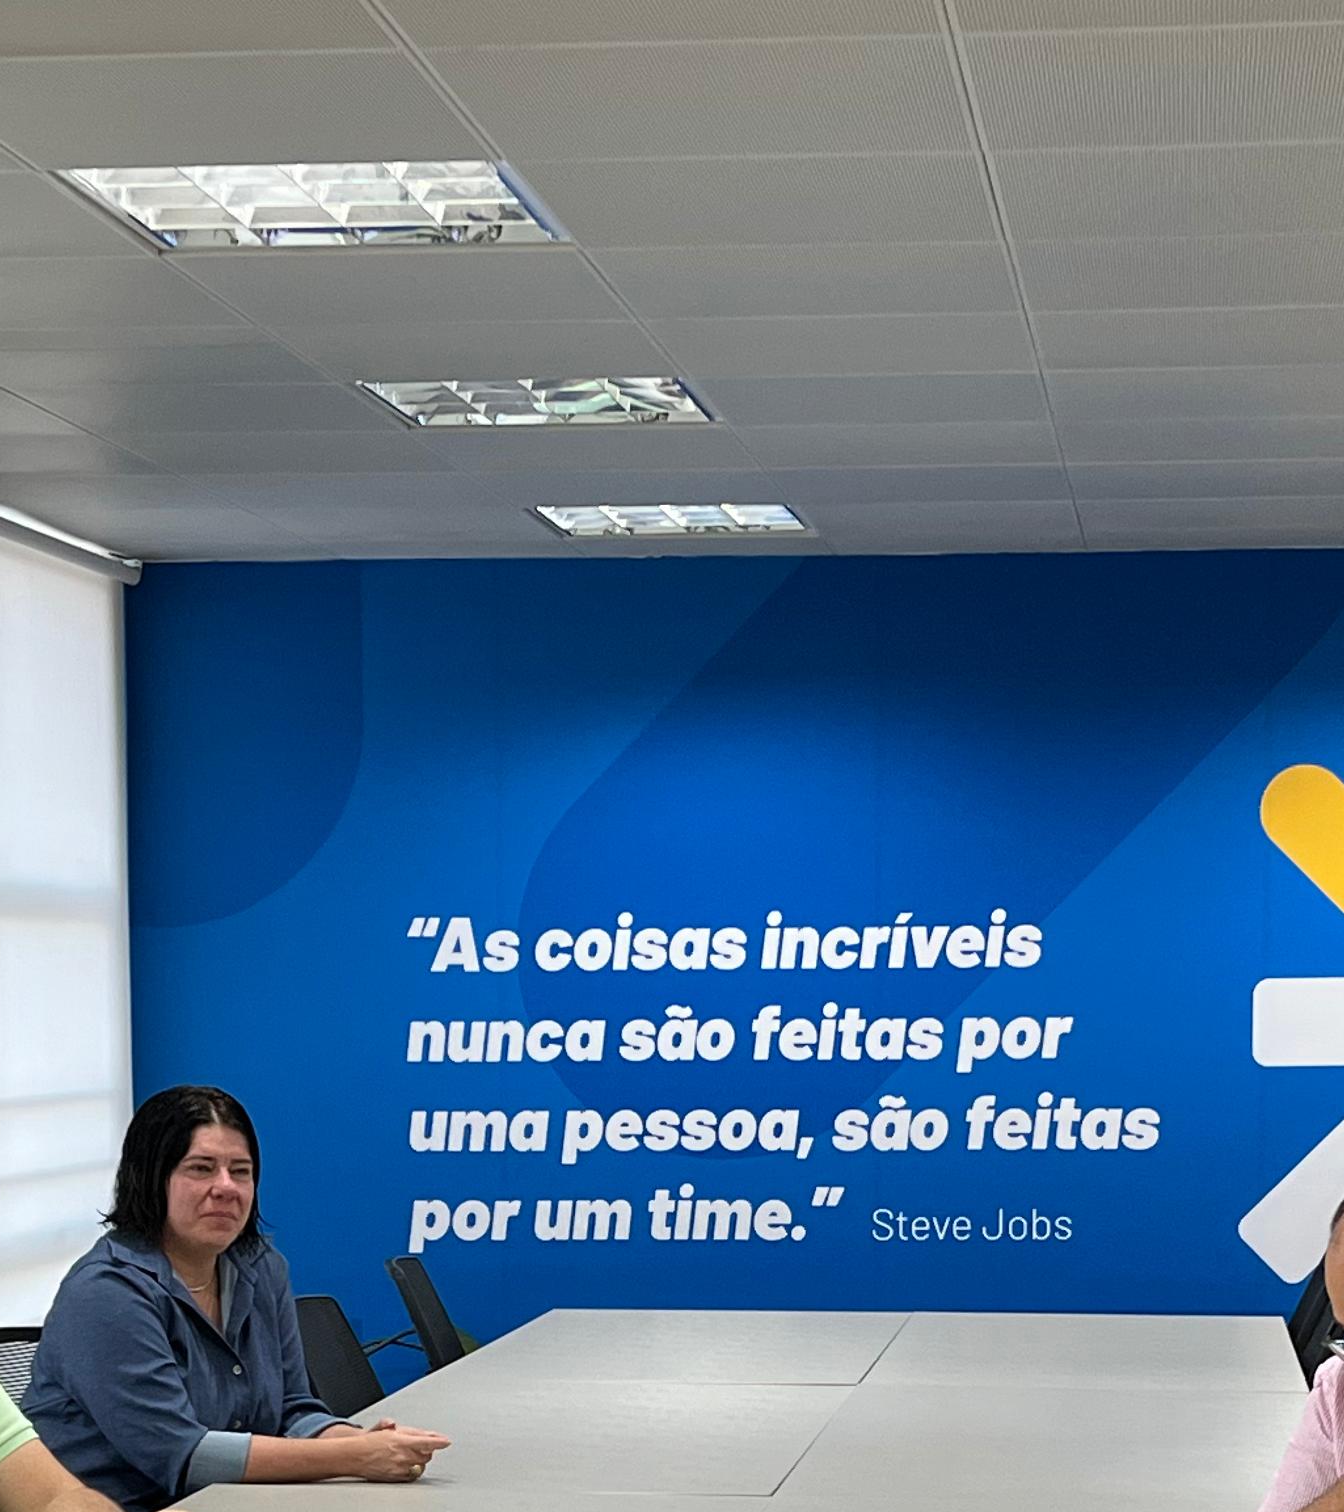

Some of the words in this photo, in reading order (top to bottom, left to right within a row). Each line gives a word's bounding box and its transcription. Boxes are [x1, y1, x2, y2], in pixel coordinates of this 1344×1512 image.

[534, 911, 747, 972] coisas
[760, 908, 1043, 970] incríveis
[406, 1018, 605, 1062] nunca
[619, 1004, 736, 1062] são
[751, 1001, 944, 1061] feitas
[956, 1016, 1074, 1073] por
[409, 1109, 550, 1152] uma
[561, 1108, 814, 1165] pessoa,
[831, 1094, 949, 1152] são
[965, 1091, 1161, 1150] feitas
[408, 1198, 522, 1254] por
[534, 1198, 632, 1241] um
[872, 1208, 971, 1241] Steve
[982, 1208, 1072, 1241] Jobs
